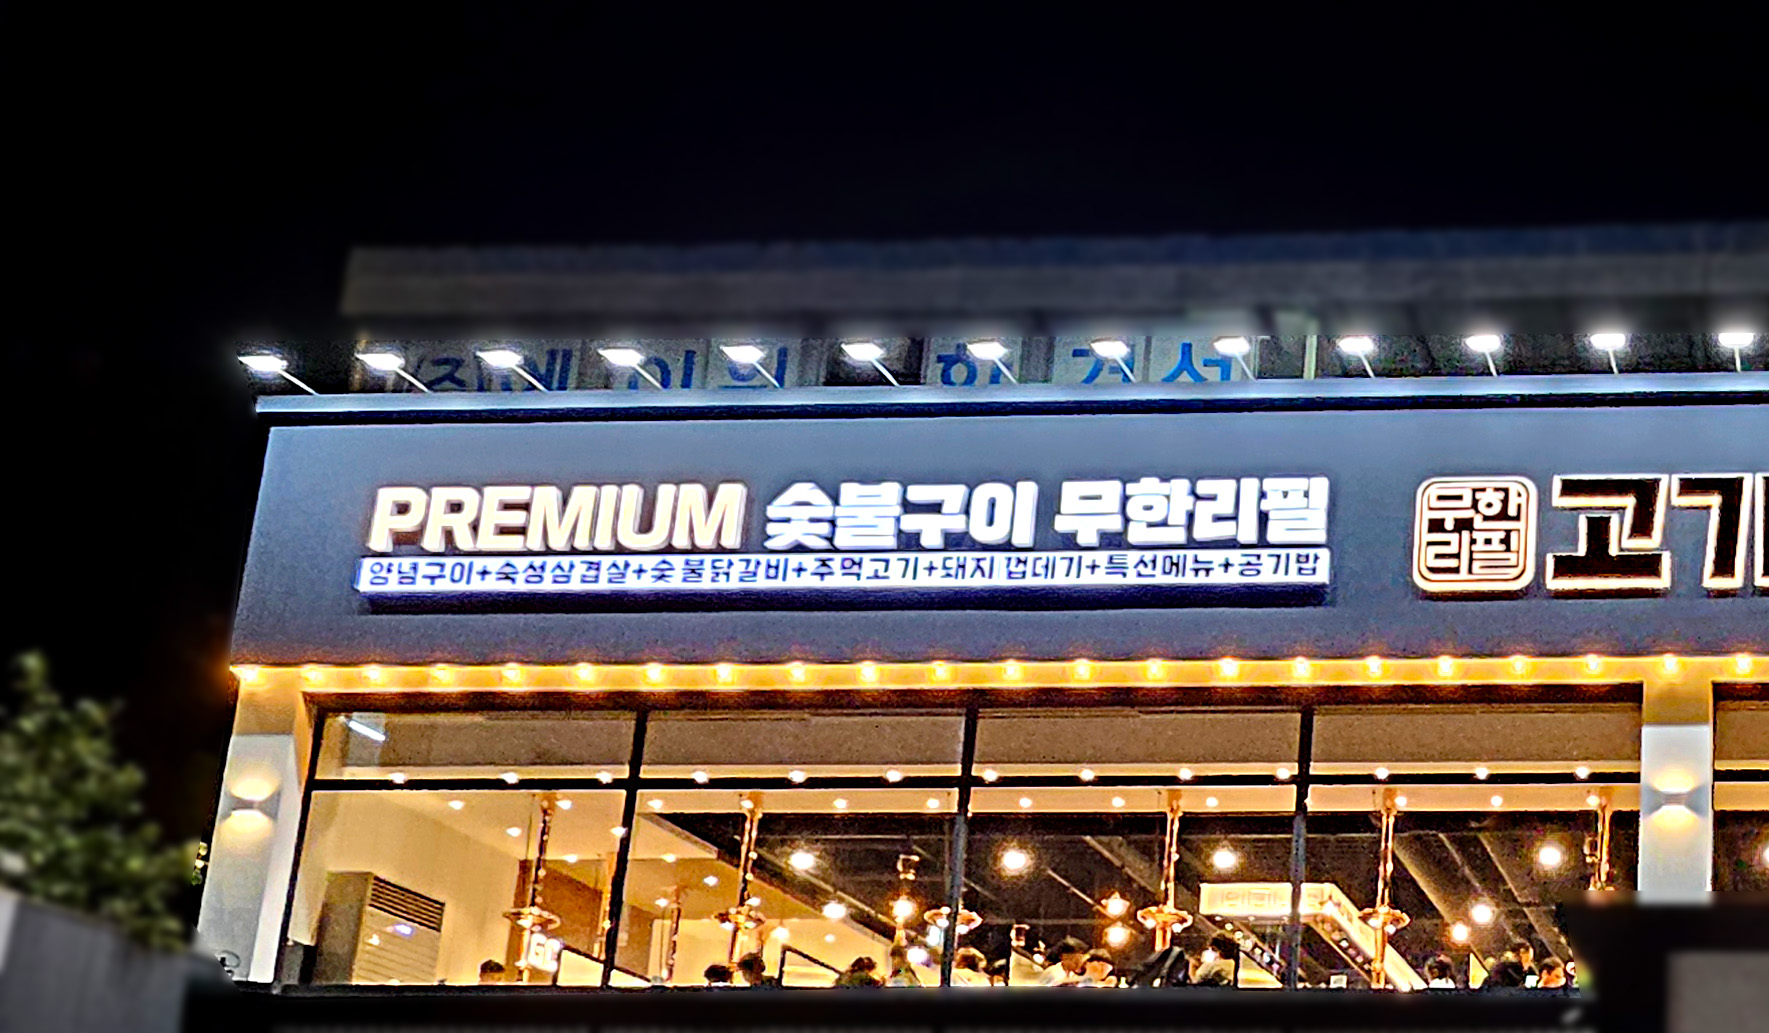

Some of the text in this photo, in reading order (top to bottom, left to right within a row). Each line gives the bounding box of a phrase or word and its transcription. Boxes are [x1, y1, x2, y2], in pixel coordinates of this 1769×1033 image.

[367, 476, 1331, 553] PREMIUM 숯불구이 무한리필
[1426, 486, 1527, 534] 무한
[1424, 532, 1526, 582] 리필
